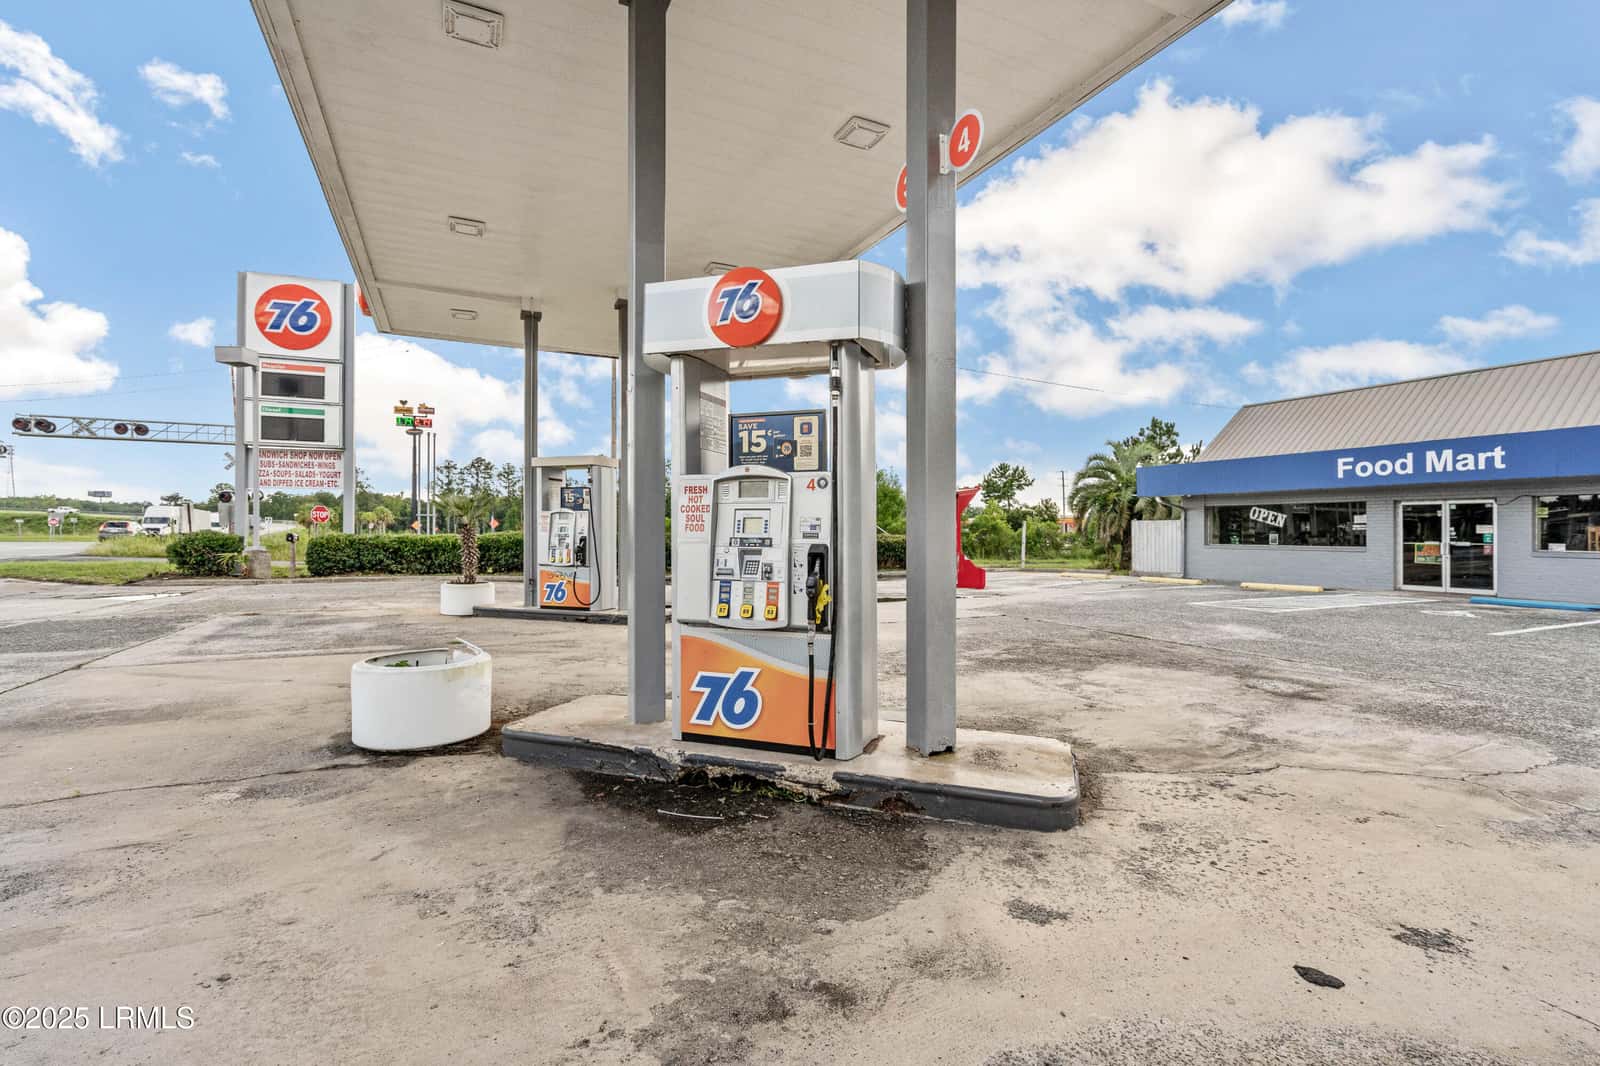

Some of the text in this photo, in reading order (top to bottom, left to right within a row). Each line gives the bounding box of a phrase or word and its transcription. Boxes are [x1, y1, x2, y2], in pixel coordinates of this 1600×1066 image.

[957, 126, 971, 153] 4
[716, 279, 764, 326] 76
[264, 298, 321, 336] 76
[738, 423, 758, 431] SAVE
[290, 449, 307, 459] SHOP
[308, 450, 323, 460] NOW
[324, 450, 342, 461] OPEN
[1337, 445, 1506, 479] Food Mart
[684, 485, 708, 495] FRESH
[806, 478, 816, 492] 4
[688, 495, 703, 504] HOT
[680, 504, 710, 513] COOKED
[685, 514, 705, 523] SOUL
[1249, 506, 1288, 528] OPEN
[684, 523, 705, 532] FOOD
[543, 580, 568, 602] 76
[689, 666, 763, 730] 76
